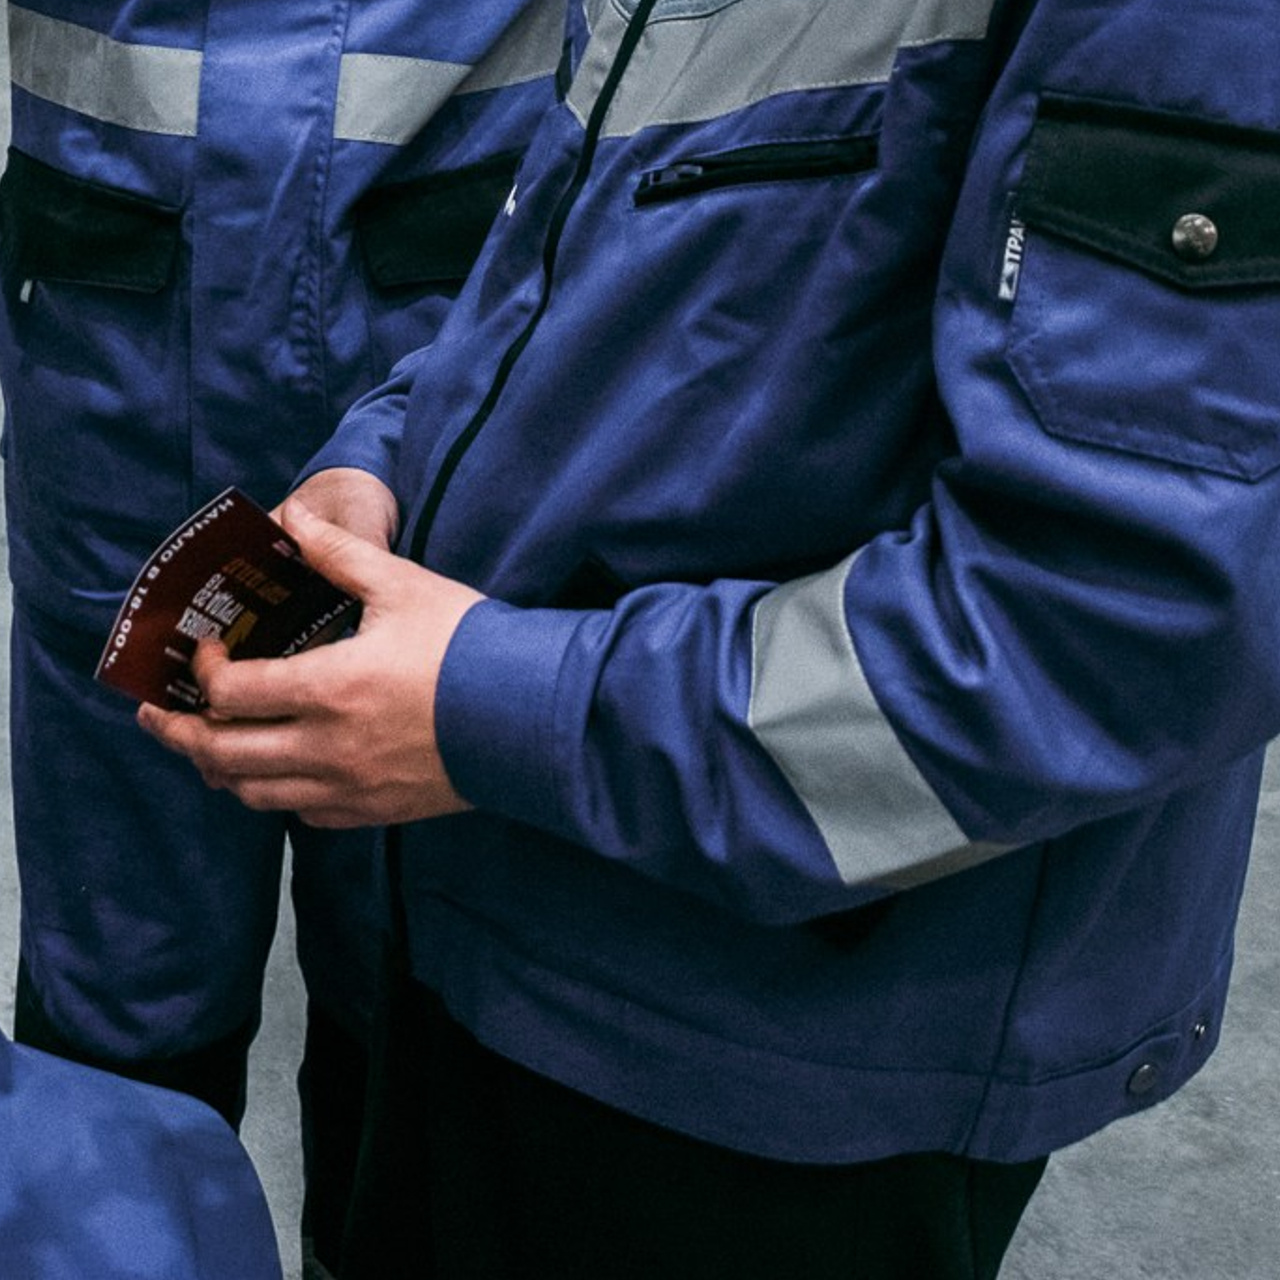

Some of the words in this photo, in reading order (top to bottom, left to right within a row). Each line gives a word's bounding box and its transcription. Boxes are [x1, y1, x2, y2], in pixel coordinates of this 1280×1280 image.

[160, 498, 234, 563] НАЧАЛО
[147, 565, 160, 579] В
[115, 587, 149, 649] 18-00
